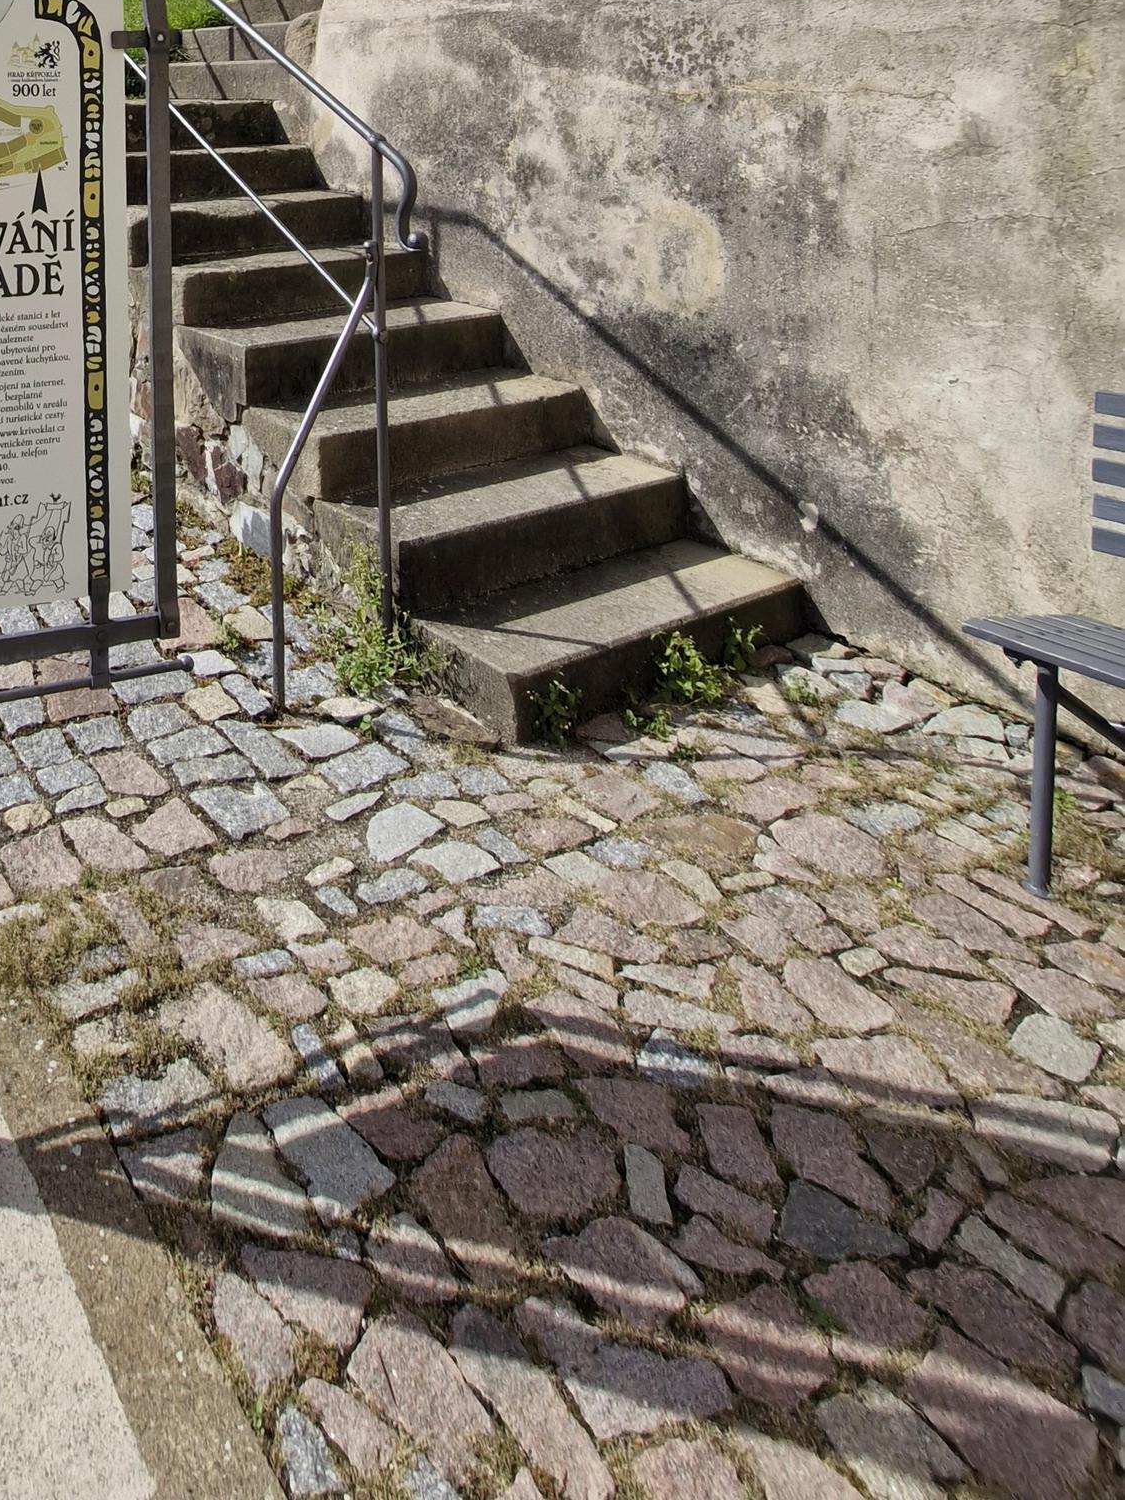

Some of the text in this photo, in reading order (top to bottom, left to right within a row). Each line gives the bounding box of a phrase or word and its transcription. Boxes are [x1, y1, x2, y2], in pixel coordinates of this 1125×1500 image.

[12, 83, 56, 97] 900 let
[17, 311, 42, 321] stanici
[51, 310, 60, 318] let
[29, 321, 68, 331] sousedství
[1, 344, 39, 356] ubytování
[42, 344, 56, 353] pro
[5, 391, 42, 402] bezplatné
[43, 398, 68, 408] areálu
[6, 412, 42, 423] turistické
[0, 425, 65, 437] www.krivoklat.cz
[36, 436, 60, 445] centru
[21, 447, 48, 458] telefon
